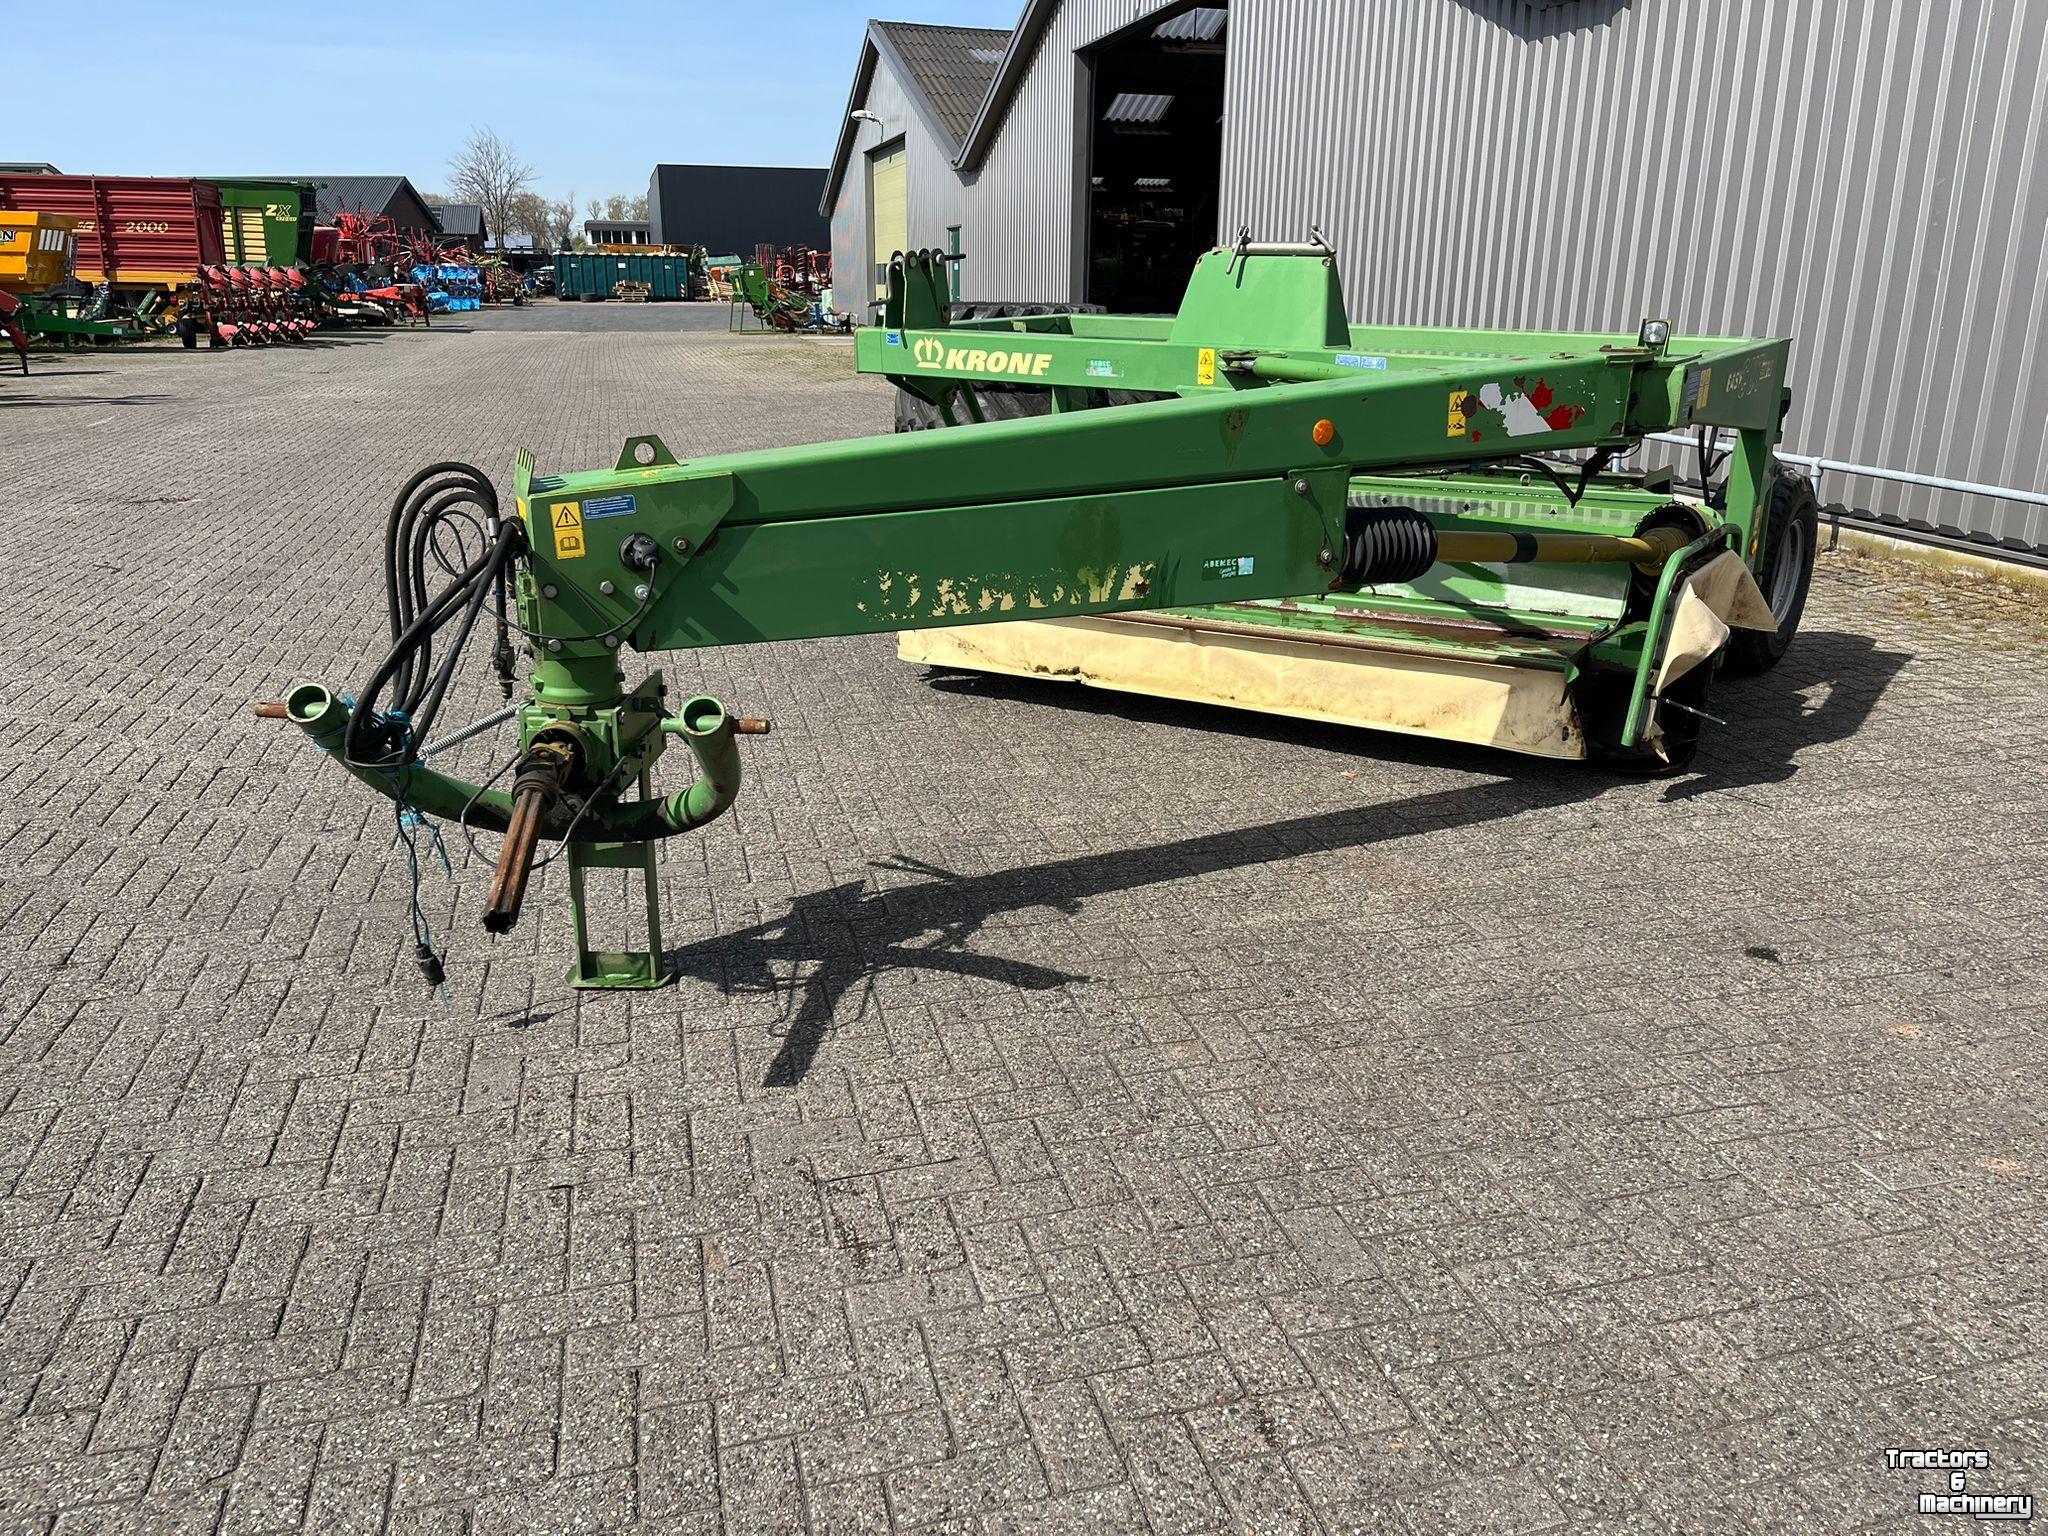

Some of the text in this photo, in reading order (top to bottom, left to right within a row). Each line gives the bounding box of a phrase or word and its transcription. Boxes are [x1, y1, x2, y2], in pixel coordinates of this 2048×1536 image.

[265, 204, 292, 217] ZX
[125, 221, 169, 234] 2000
[1203, 558, 1237, 569] ABEMEC
